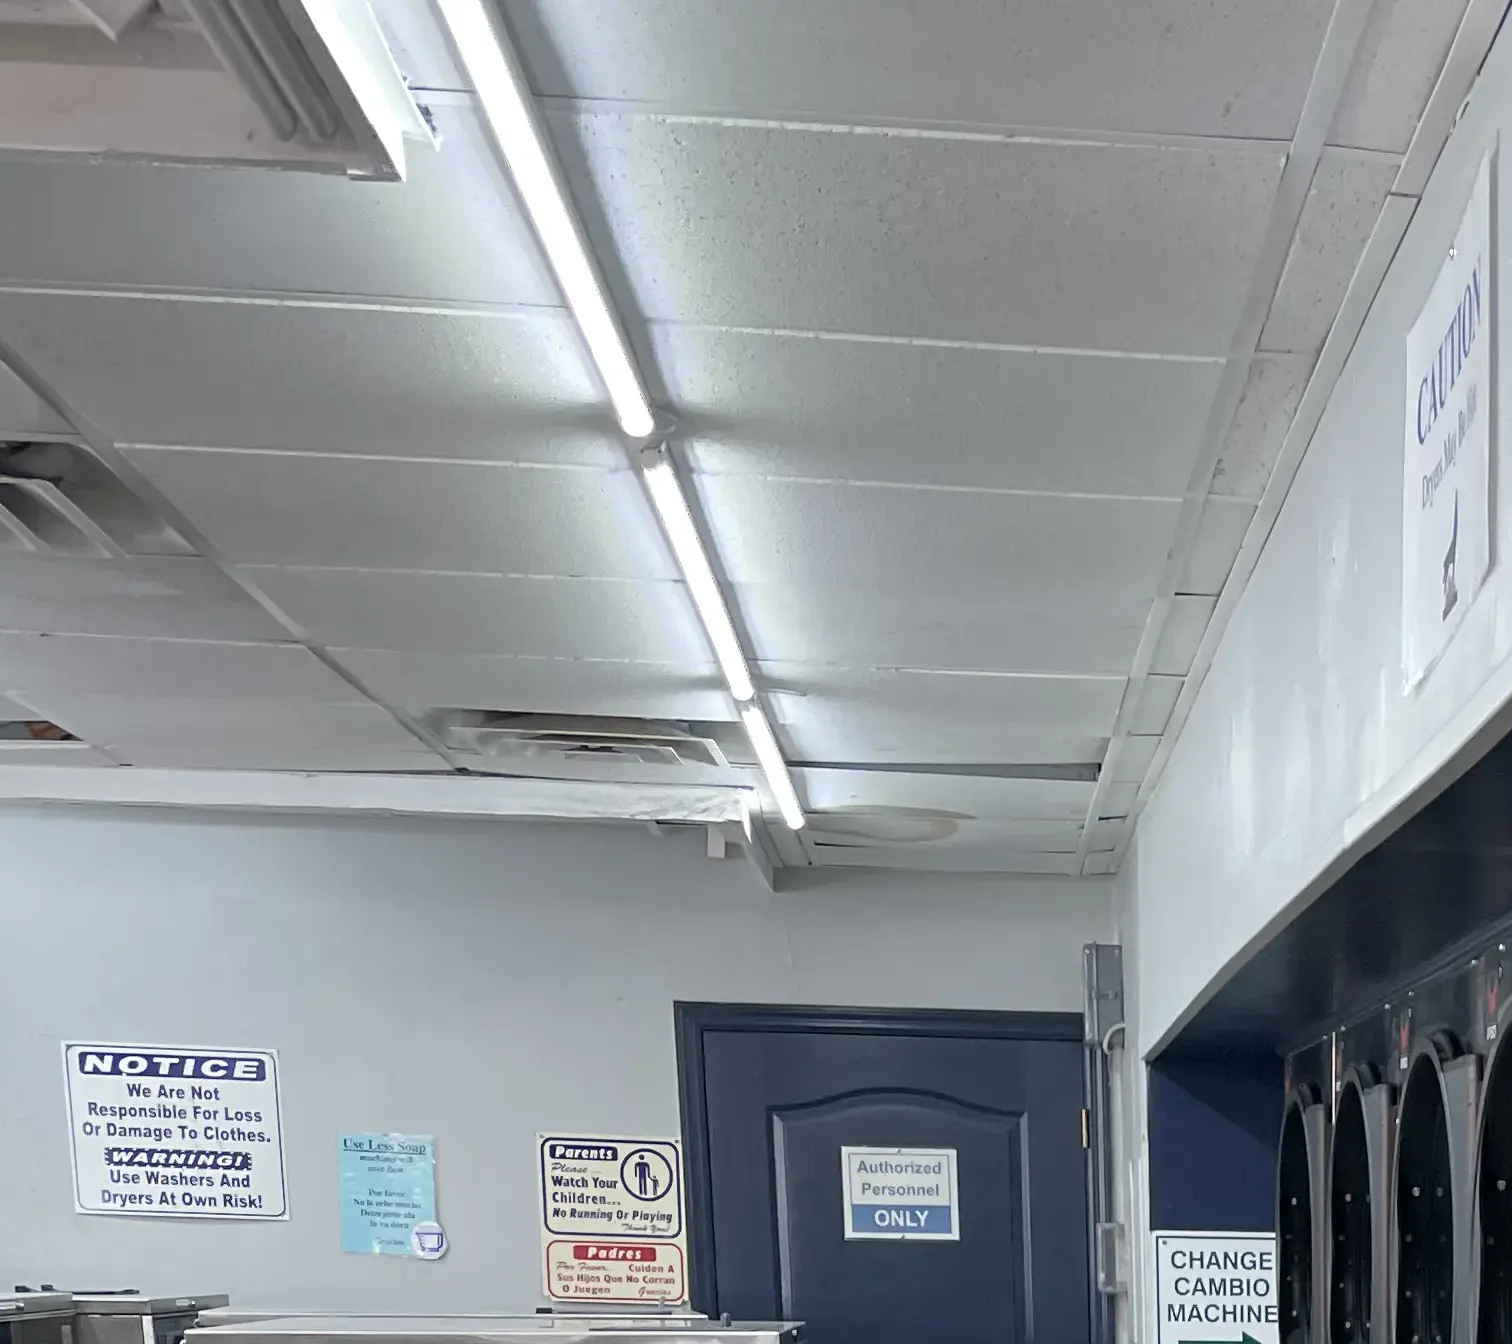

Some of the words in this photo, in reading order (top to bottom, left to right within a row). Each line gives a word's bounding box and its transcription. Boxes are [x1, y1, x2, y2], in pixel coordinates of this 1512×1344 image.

[1417, 253, 1481, 446] CAUTION
[84, 1054, 260, 1079] NOTICE
[126, 1083, 152, 1098] We
[157, 1084, 186, 1099] Are
[191, 1086, 220, 1101] Not
[87, 1102, 188, 1120] Responsible
[193, 1106, 219, 1121] For
[224, 1107, 263, 1122] Loss
[82, 1122, 101, 1136] Or
[106, 1122, 173, 1142] Damage
[178, 1125, 199, 1140] To
[203, 1126, 272, 1143] Clothes.
[343, 1137, 365, 1150] Use
[368, 1139, 394, 1152] Less
[397, 1141, 427, 1155] Soap
[555, 1146, 613, 1160] Parents
[111, 1151, 244, 1168] WARNING!
[857, 1160, 942, 1174] Authorized
[110, 1169, 141, 1185] Use
[145, 1170, 215, 1187] Washers
[220, 1173, 251, 1189] And
[551, 1175, 588, 1188] Watch
[592, 1176, 618, 1189] Your
[861, 1182, 940, 1196] Personnel
[101, 1189, 154, 1208] Dryers
[158, 1192, 177, 1206] At
[181, 1192, 218, 1207] Own
[223, 1193, 263, 1209] Risk!
[552, 1191, 621, 1206] Children...
[552, 1207, 567, 1218] No
[570, 1208, 613, 1221] Running
[616, 1210, 629, 1220] Or
[632, 1210, 673, 1223] Playing
[874, 1209, 929, 1227] ONLY
[587, 1246, 642, 1260] Padres
[1170, 1250, 1273, 1271] CHANGE
[628, 1263, 664, 1273] Cuiden
[668, 1264, 675, 1273] A
[557, 1272, 575, 1282] Sus
[577, 1273, 601, 1283] Hijos
[604, 1274, 623, 1284] Que
[626, 1275, 639, 1283] No
[642, 1275, 676, 1284] Corran
[1174, 1277, 1271, 1297] CAMBIO
[562, 1284, 570, 1293] O
[573, 1284, 611, 1295] Juegen
[1167, 1303, 1279, 1323] MACHINE
